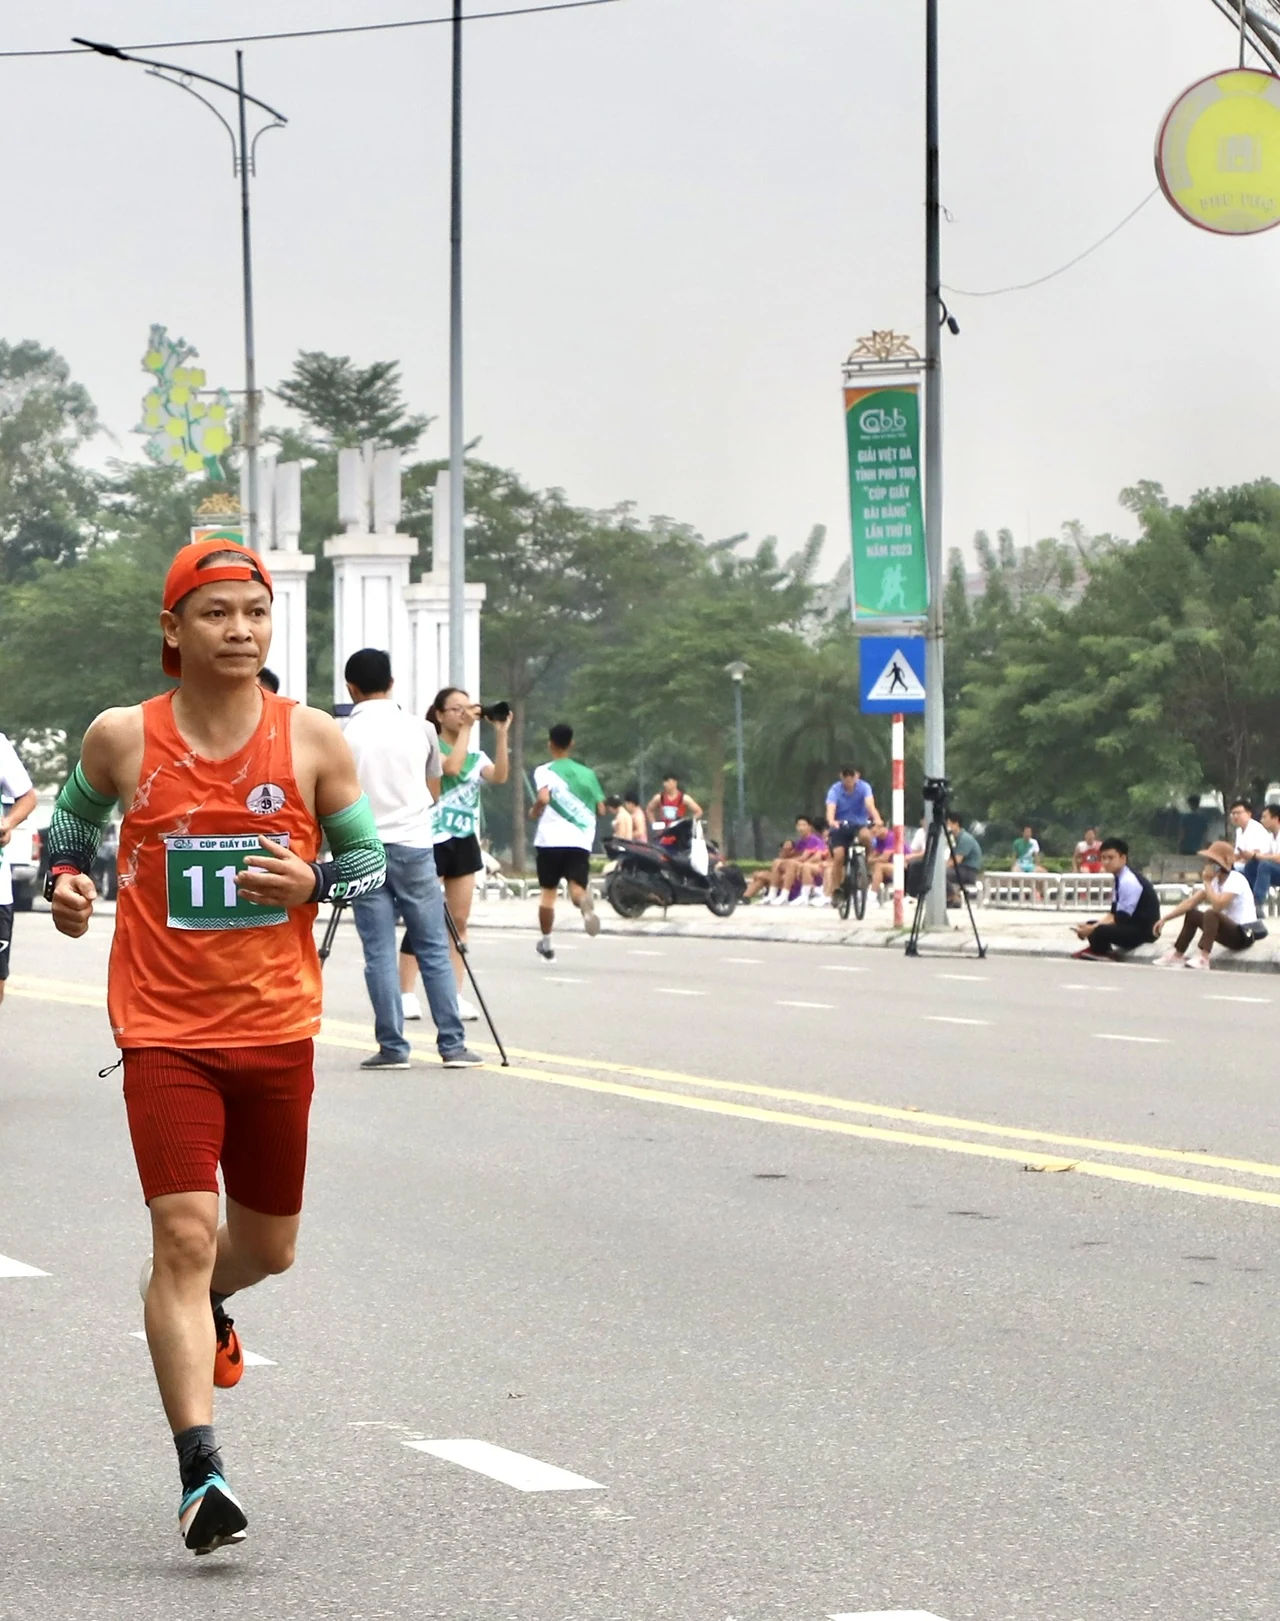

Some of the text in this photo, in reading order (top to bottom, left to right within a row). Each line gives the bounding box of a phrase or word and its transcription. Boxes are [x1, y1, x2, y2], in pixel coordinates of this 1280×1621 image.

[878, 446, 897, 463] VIỆT
[878, 466, 897, 480] PHÚ
[898, 466, 917, 481] THỌ
[446, 812, 471, 832] 143
[219, 838, 240, 848] GIẤY
[328, 864, 387, 900] SPORTS
